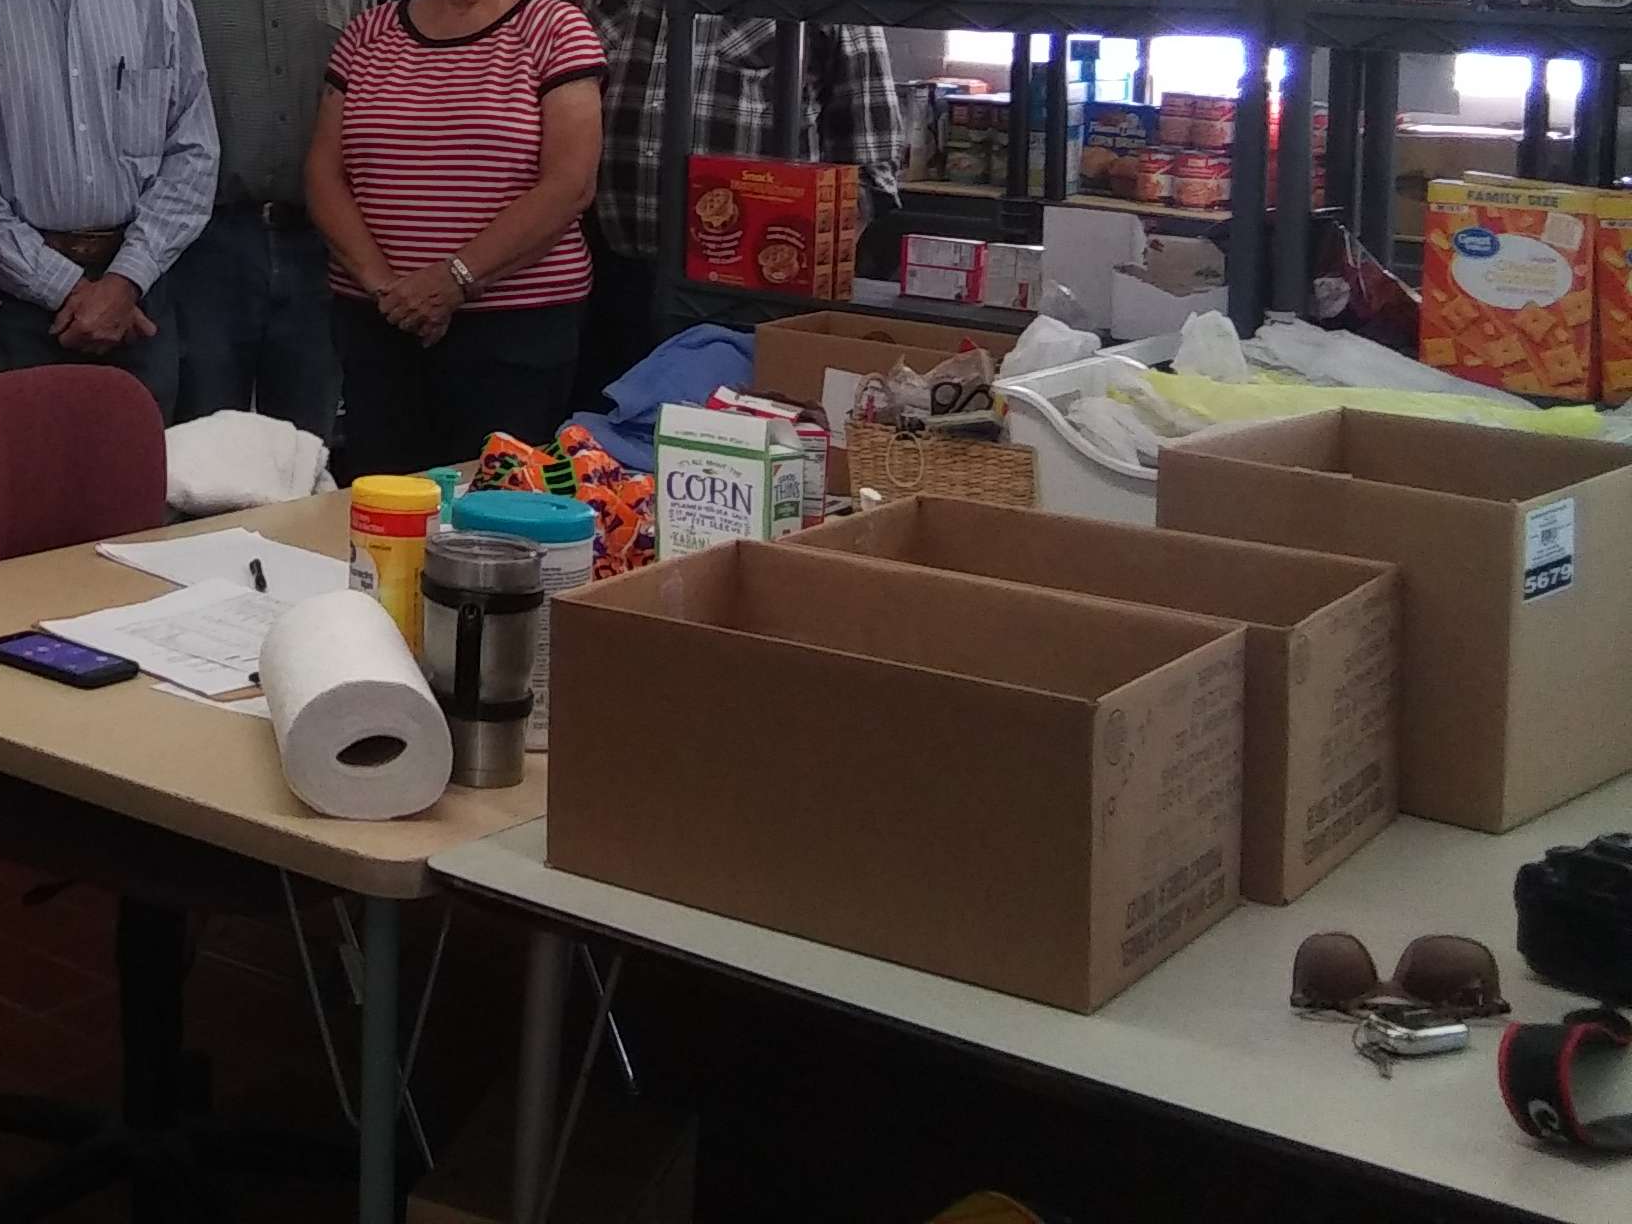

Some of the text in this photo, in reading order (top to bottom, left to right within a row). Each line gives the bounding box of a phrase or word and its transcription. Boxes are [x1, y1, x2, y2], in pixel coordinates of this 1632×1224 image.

[1468, 190, 1522, 205] FAMILY
[667, 471, 752, 515] CORN
[1524, 563, 1572, 594] 5679
